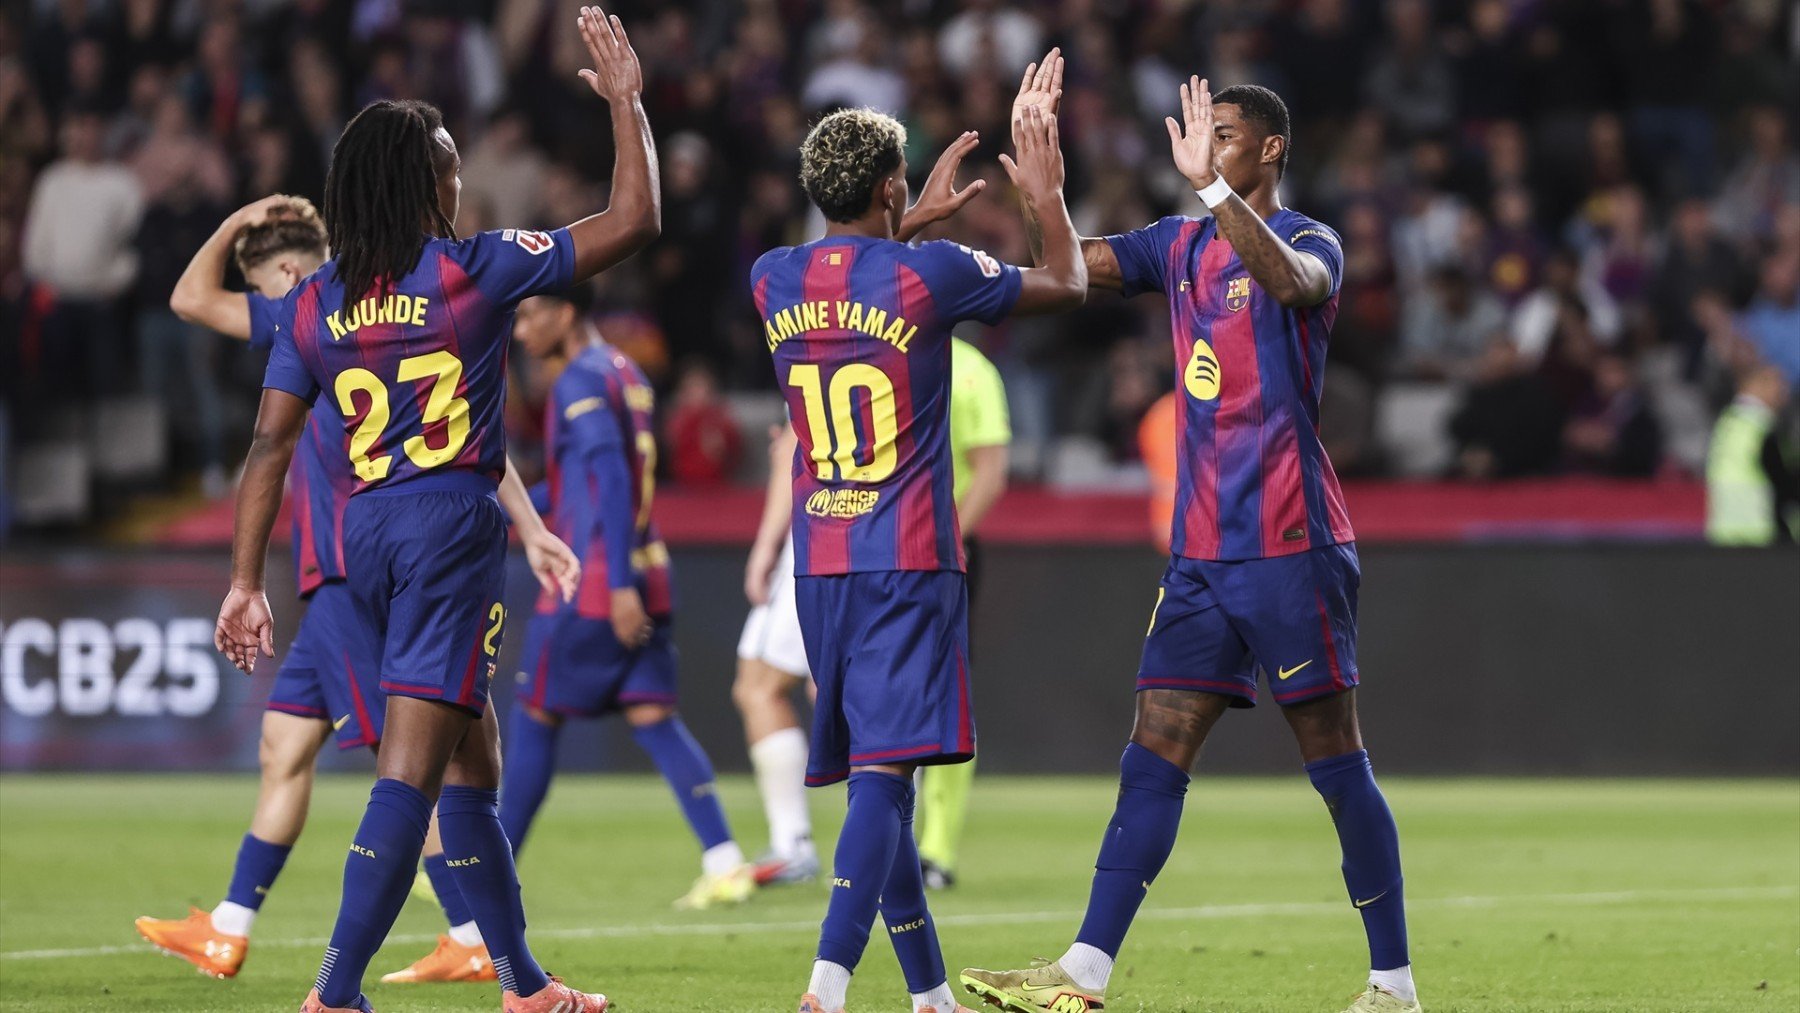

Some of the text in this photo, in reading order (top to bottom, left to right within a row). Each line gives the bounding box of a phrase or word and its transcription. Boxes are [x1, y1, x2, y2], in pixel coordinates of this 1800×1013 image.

[836, 301, 918, 354] YAMAL
[334, 350, 471, 482] 23
[788, 363, 898, 482] 10
[0, 618, 219, 717] CB25
